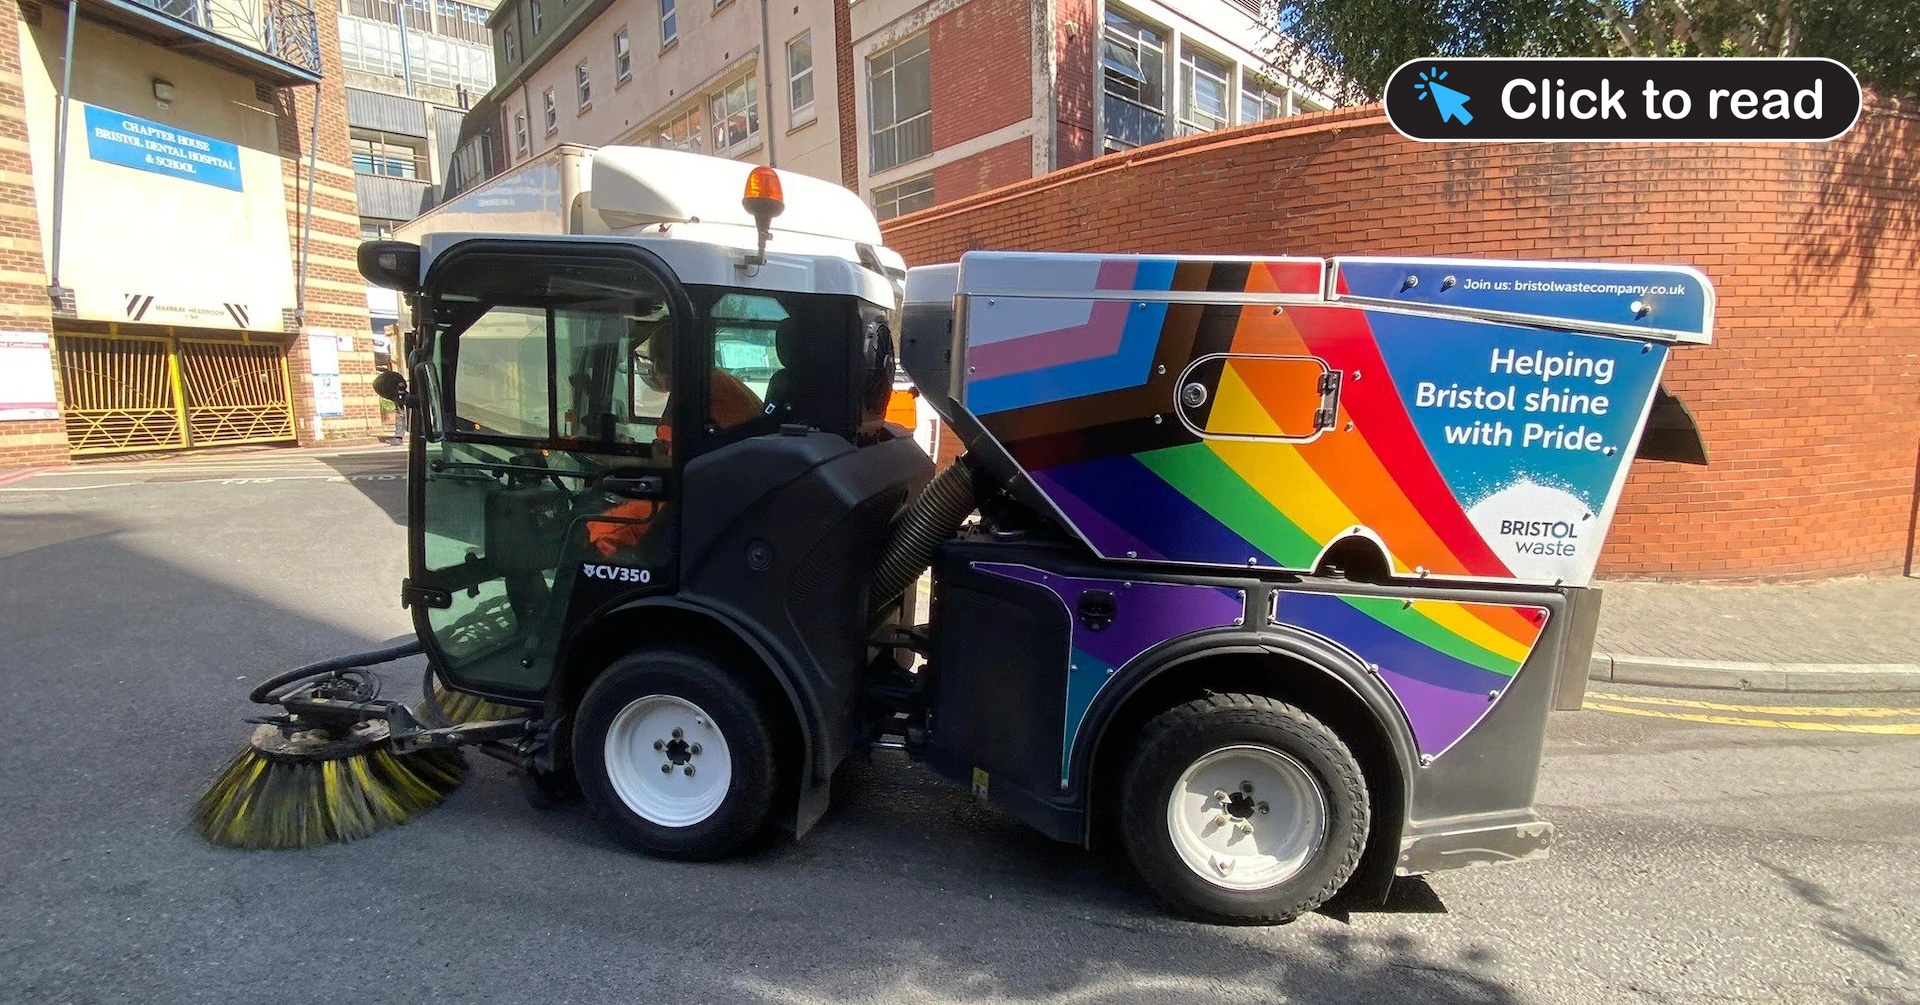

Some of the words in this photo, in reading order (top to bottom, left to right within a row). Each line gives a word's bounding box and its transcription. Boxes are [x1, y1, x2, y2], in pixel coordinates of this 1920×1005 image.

[122, 120, 176, 142] CHAPTER
[178, 135, 210, 151] HOUSE
[95, 127, 144, 148] BRISTOL
[145, 140, 187, 159] DENTAL
[188, 150, 235, 170] HOSPITAL
[145, 153, 155, 165] &
[155, 155, 196, 174] SCHOOL
[1463, 278, 1491, 291] Join
[1494, 281, 1512, 292] us:
[1514, 280, 1685, 297] bristolwastecompany.co.uk
[1490, 348, 1615, 385] Helping
[1415, 381, 1516, 411] Bristol
[1524, 387, 1610, 415] shine
[1445, 420, 1513, 447] with
[1500, 520, 1578, 539] BRISTOL
[1515, 540, 1576, 556] waste
[595, 565, 651, 583] CV350
